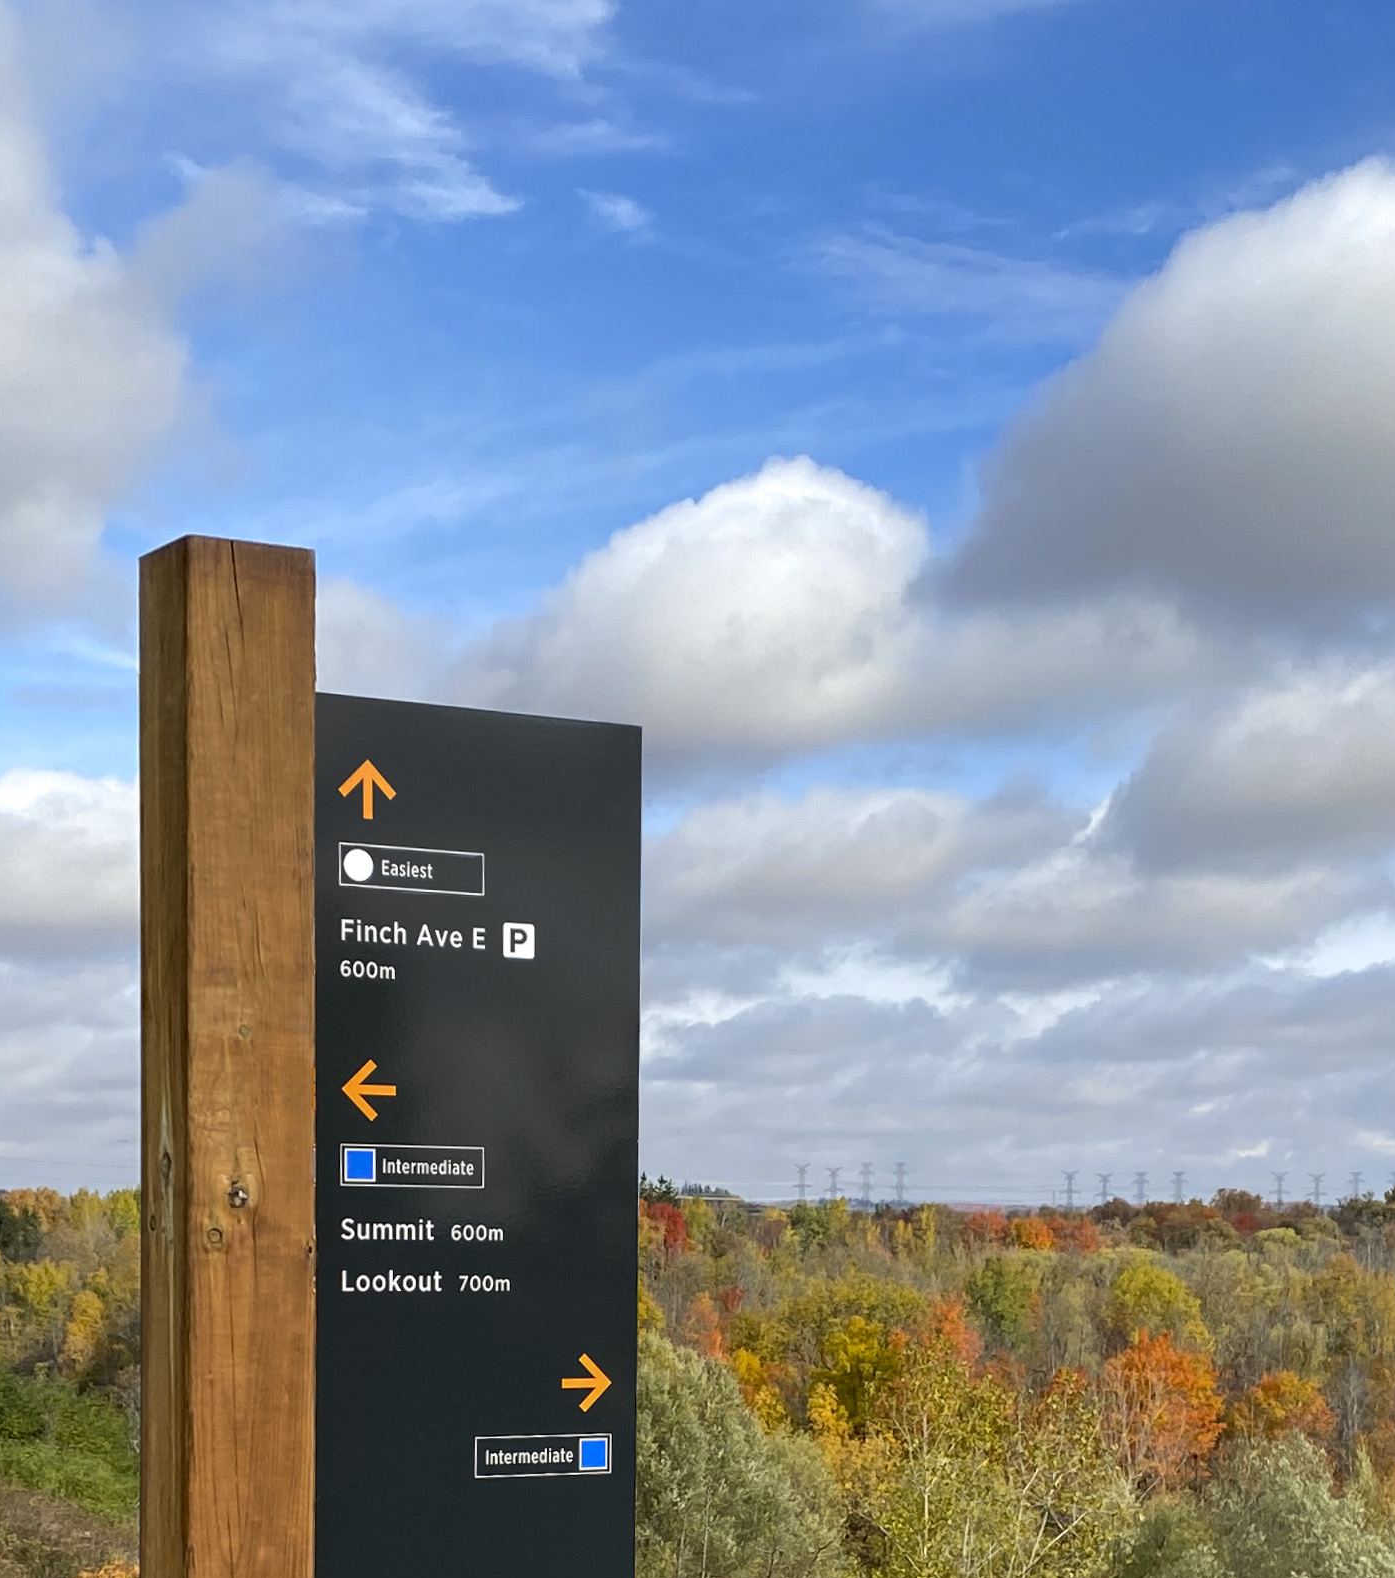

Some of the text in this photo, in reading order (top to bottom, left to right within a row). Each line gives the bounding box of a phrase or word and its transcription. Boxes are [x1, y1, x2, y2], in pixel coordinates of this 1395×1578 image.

[381, 859, 433, 879] Easiest
[340, 918, 528, 953] Finch Ave E P
[340, 960, 396, 980] 600m
[382, 1157, 474, 1176] Intermediate
[341, 1218, 504, 1242] Summit 600m
[341, 1270, 511, 1292] Lookout 700m
[485, 1448, 574, 1466] Intermediate
